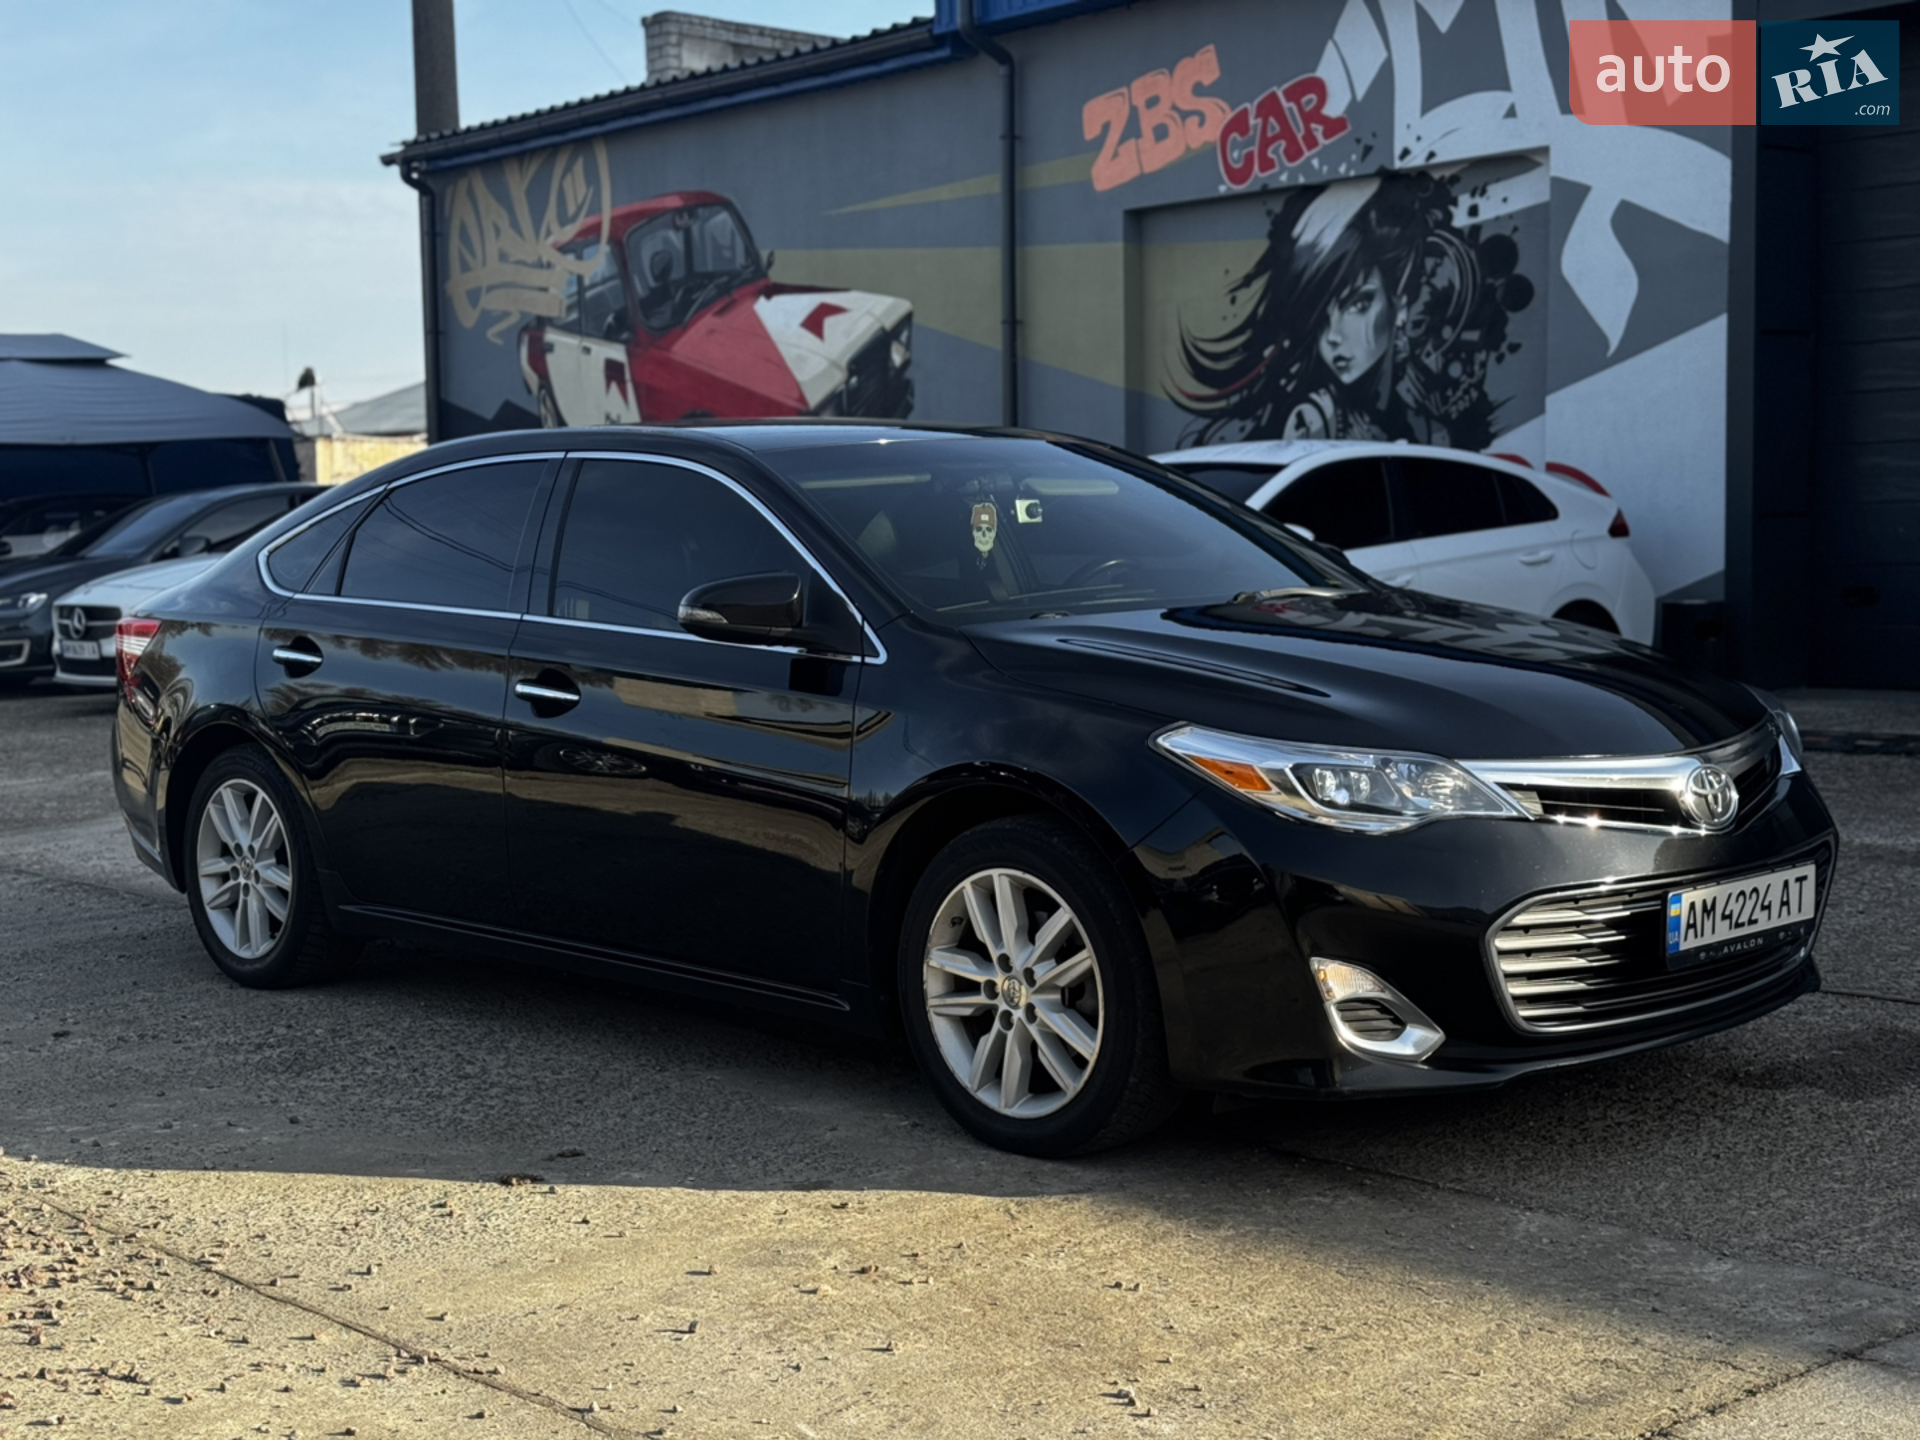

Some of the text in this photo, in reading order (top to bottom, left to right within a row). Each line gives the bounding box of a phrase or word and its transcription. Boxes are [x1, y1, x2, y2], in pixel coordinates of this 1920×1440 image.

[1082, 44, 1226, 192] ZBS
[1216, 75, 1350, 187] CAR
[1683, 875, 1808, 942] AM 4224 AT
[1669, 931, 1680, 945] UA
[1723, 937, 1764, 955] AVALON
